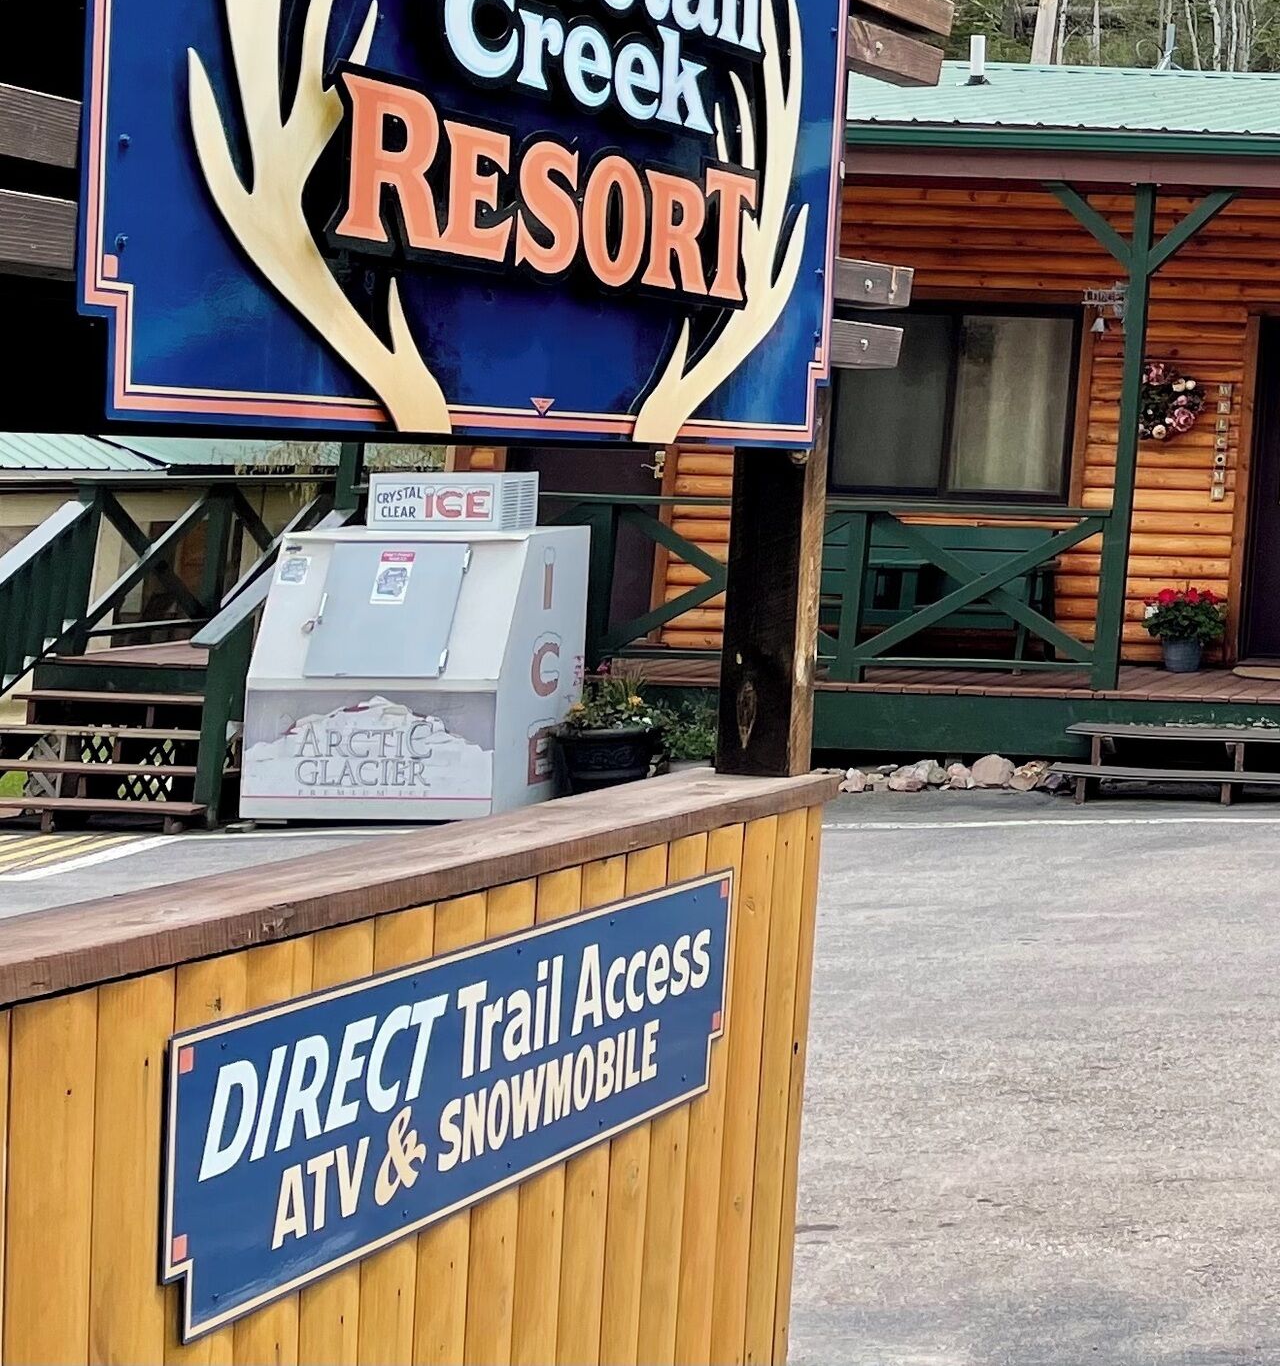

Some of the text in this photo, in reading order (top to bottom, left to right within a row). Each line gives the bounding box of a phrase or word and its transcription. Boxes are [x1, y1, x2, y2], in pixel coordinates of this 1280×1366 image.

[335, 74, 758, 302] RESORT
[377, 485, 491, 519] CRYSTAL ICE
[381, 505, 416, 519] CLEAR
[295, 719, 434, 759] ARCTIC
[295, 759, 431, 786] GLACIER
[198, 927, 712, 1182] DIRECT Trail Access
[271, 1020, 659, 1251] ATV & SNOWMOBILE
